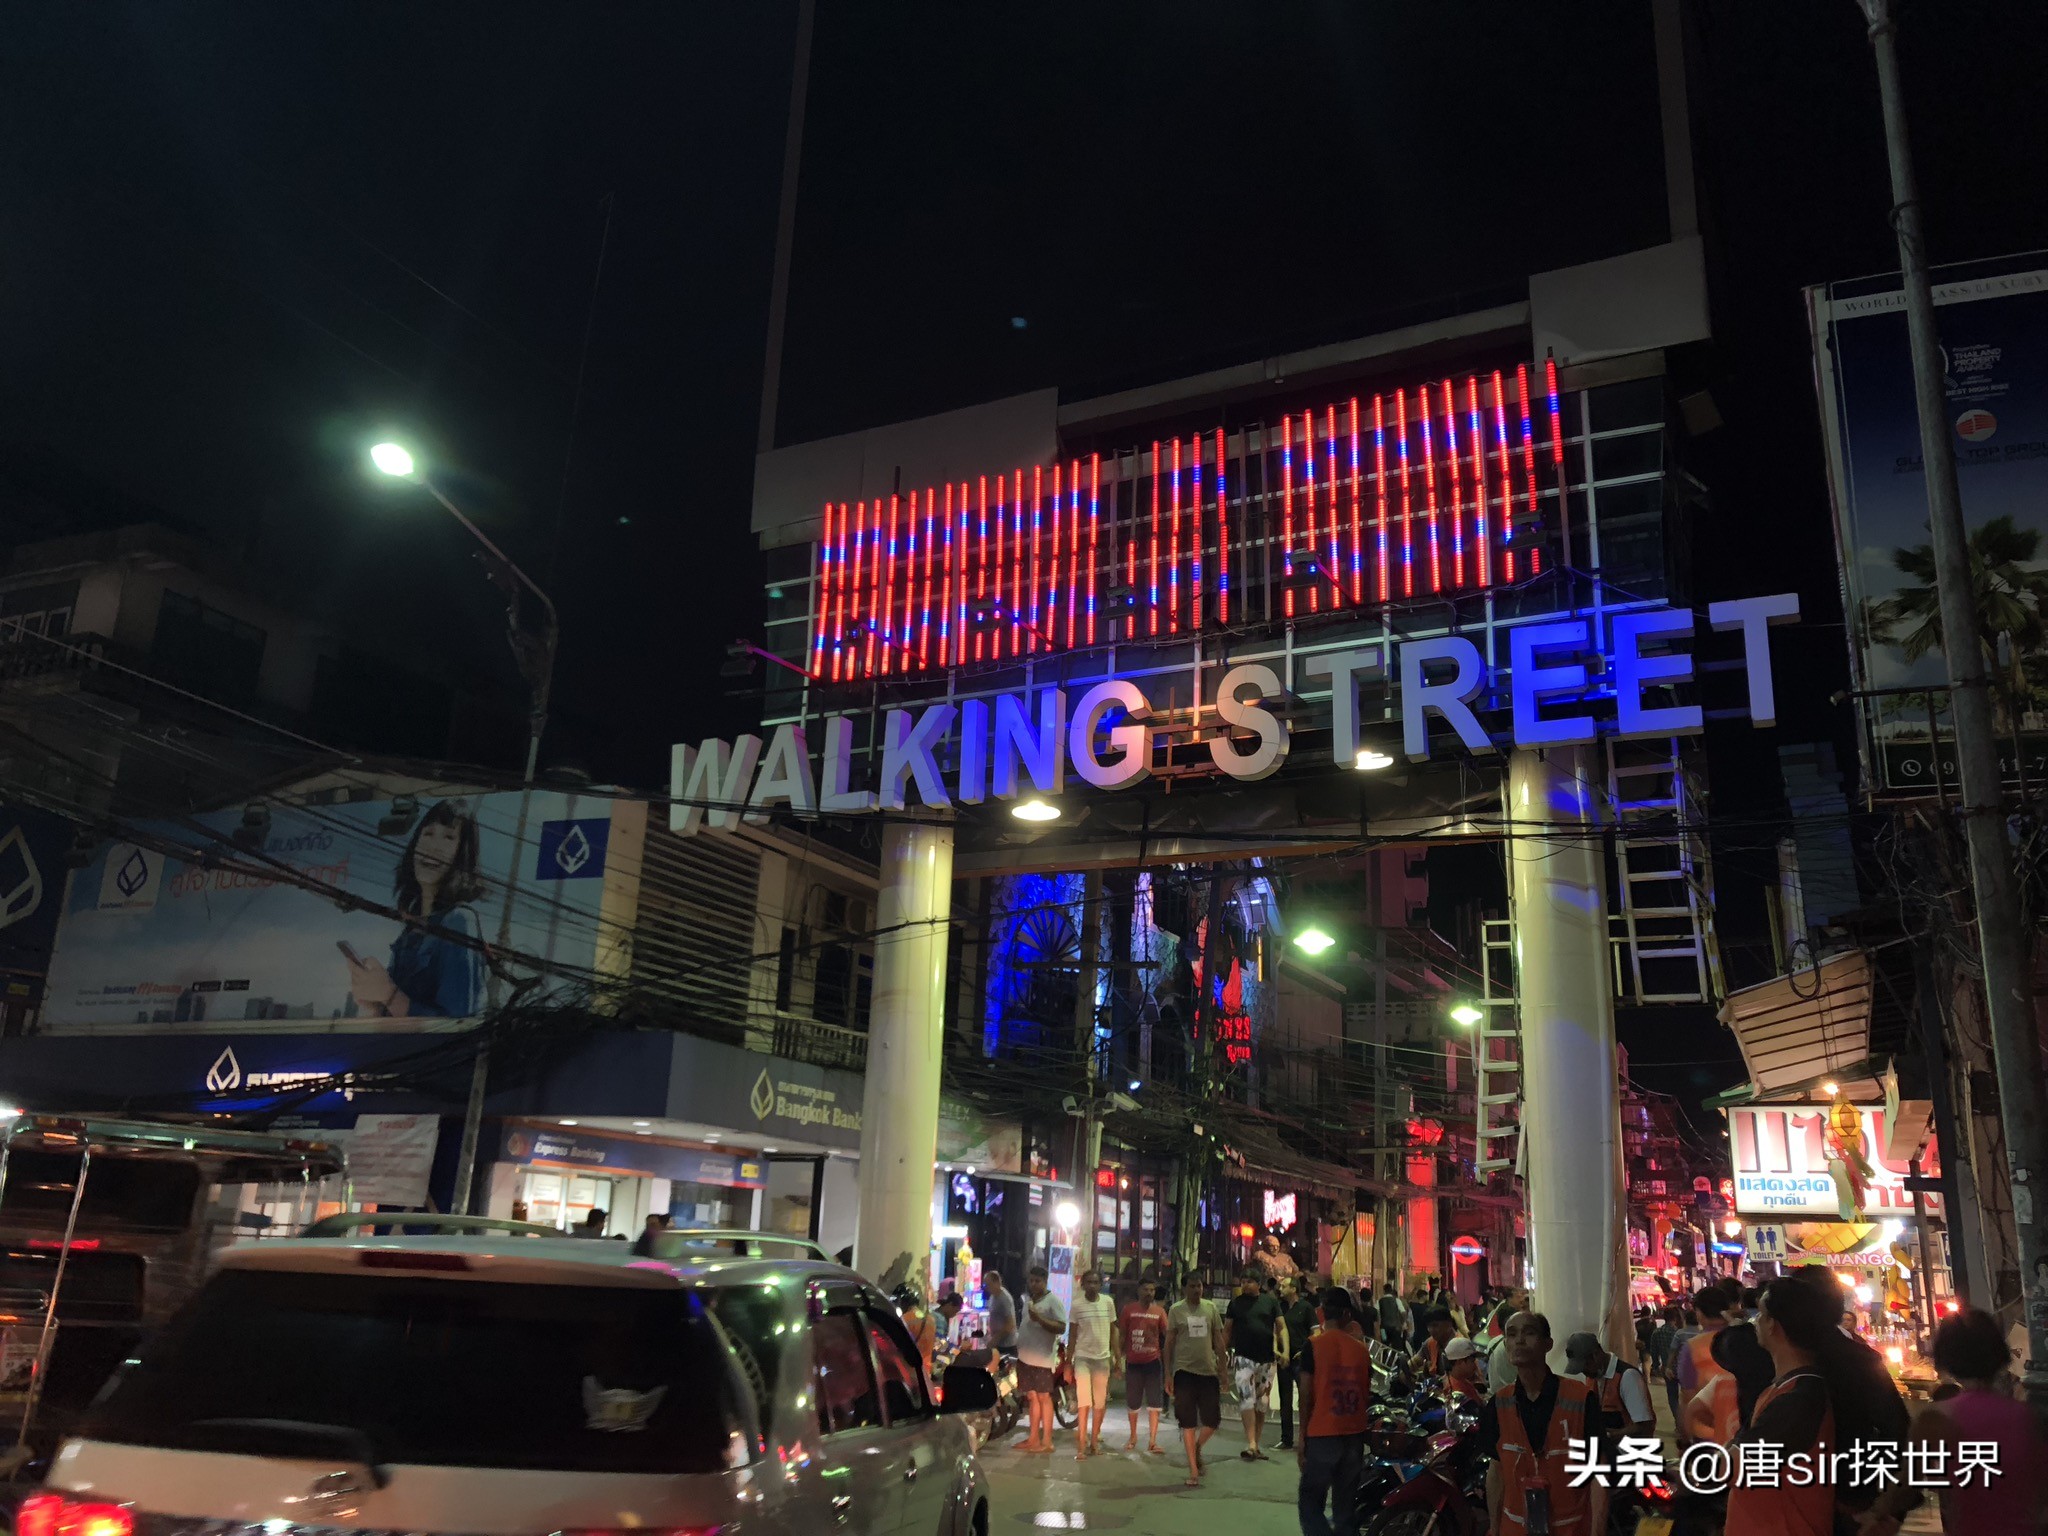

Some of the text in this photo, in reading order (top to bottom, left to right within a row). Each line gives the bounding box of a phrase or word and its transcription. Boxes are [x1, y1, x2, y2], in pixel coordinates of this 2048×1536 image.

[1845, 294, 1907, 313] WORLD
[1953, 355, 2001, 366] PROPERTY
[1954, 348, 2002, 360] THAILAND
[670, 592, 1800, 836] WALKING STREET
[775, 1096, 863, 1131] Bangkok Bank
[534, 1141, 568, 1156] Express
[1739, 1177, 1830, 1192] แสดงสด
[1753, 1252, 1775, 1260] TOILET
[1826, 1253, 1896, 1266] MANGO
